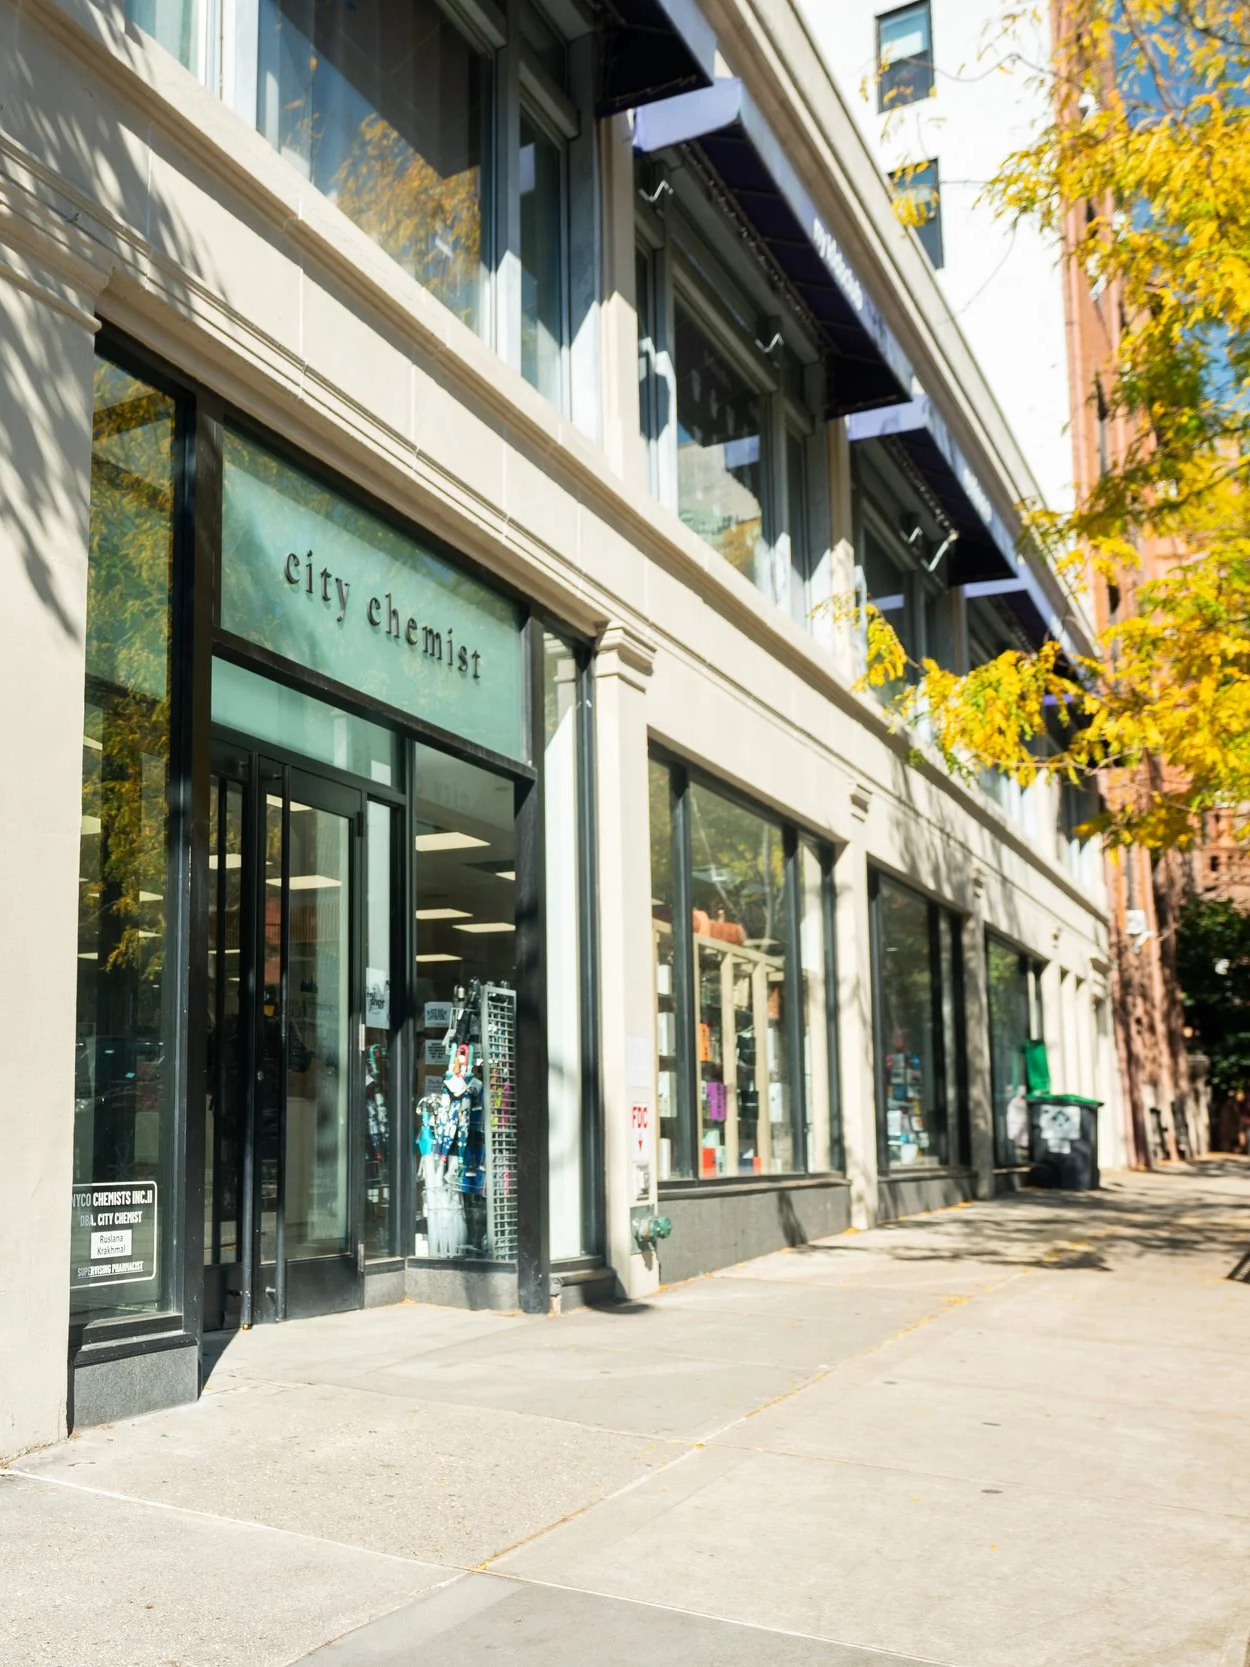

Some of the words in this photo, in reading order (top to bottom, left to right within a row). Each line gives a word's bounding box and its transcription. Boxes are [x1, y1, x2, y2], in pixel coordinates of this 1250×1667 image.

[284, 549, 350, 622] city
[367, 592, 481, 680] chemist
[632, 1106, 648, 1128] FDC
[93, 1190, 131, 1207] CHEMISTS
[97, 1212, 114, 1226] CITY
[114, 1211, 143, 1225] CHEMIST
[100, 1234, 123, 1244] Ruslana
[97, 1245, 125, 1256] Krakhmal
[77, 1264, 111, 1277] SUPERVISING
[111, 1261, 143, 1274] PHARMACIST
